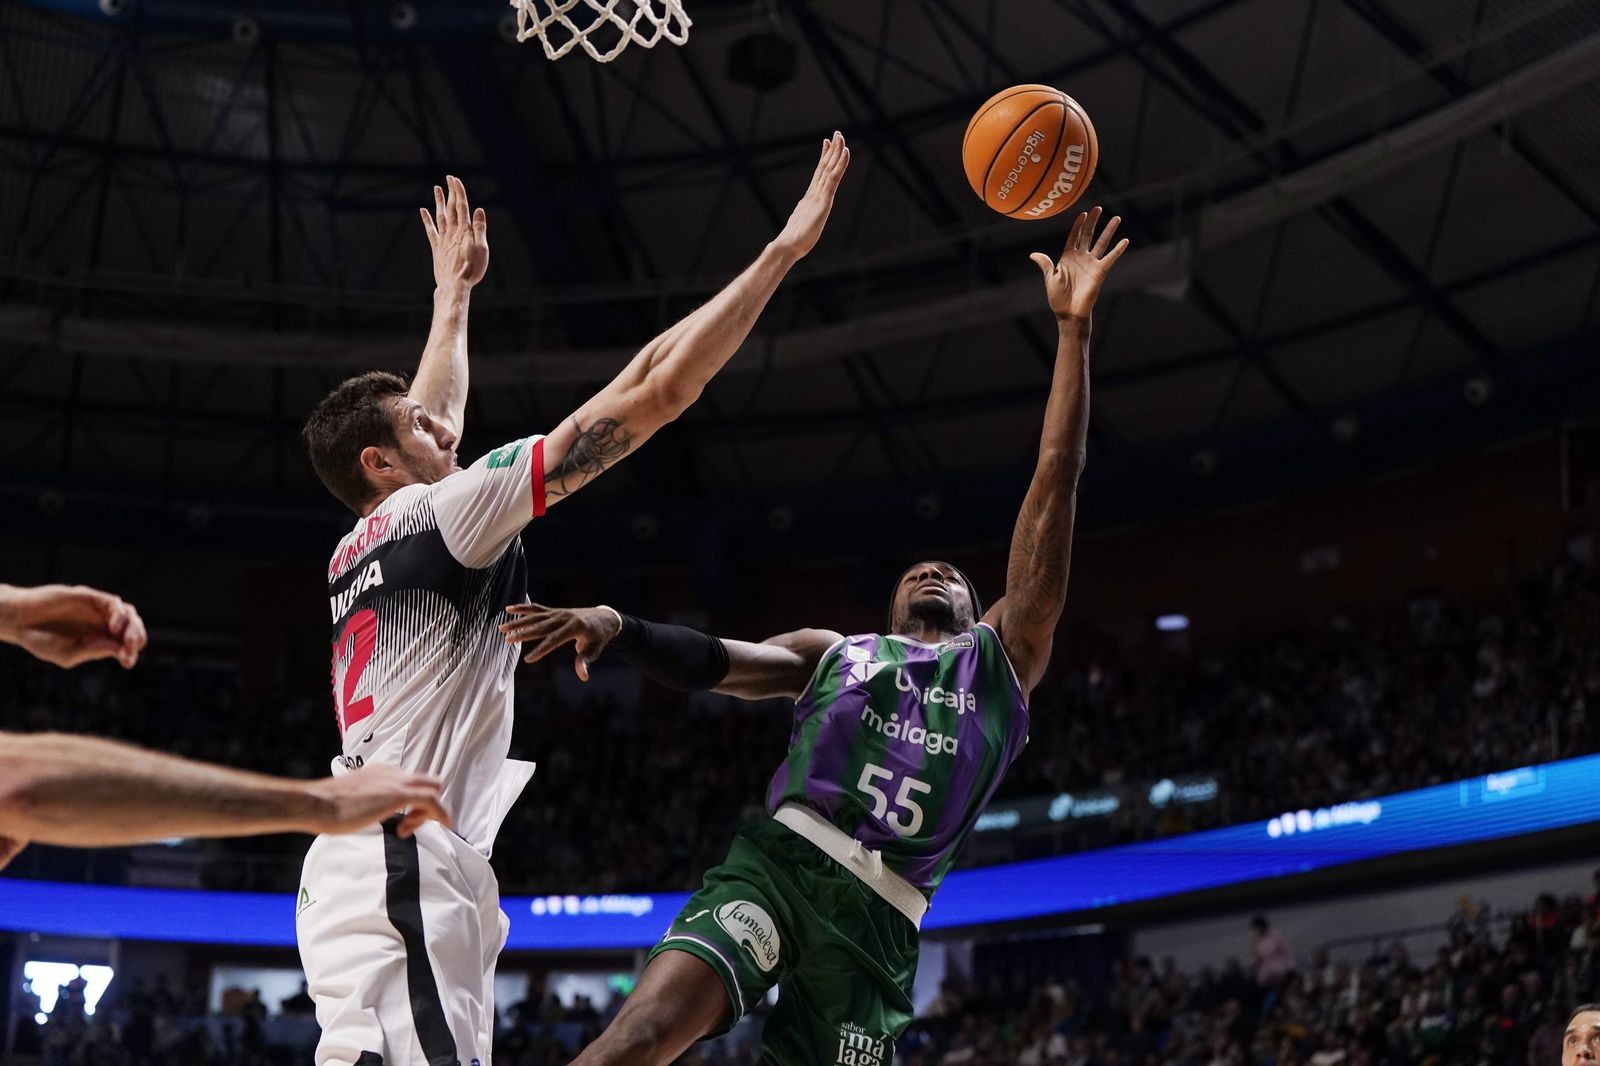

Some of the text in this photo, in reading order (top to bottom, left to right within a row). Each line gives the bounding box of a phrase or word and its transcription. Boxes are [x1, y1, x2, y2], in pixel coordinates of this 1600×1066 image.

[1023, 144, 1085, 217] Wilson
[894, 666, 977, 715] Unicaja
[856, 762, 932, 838] 55
[720, 902, 777, 966] famadesa
[840, 1021, 867, 1034] sabor
